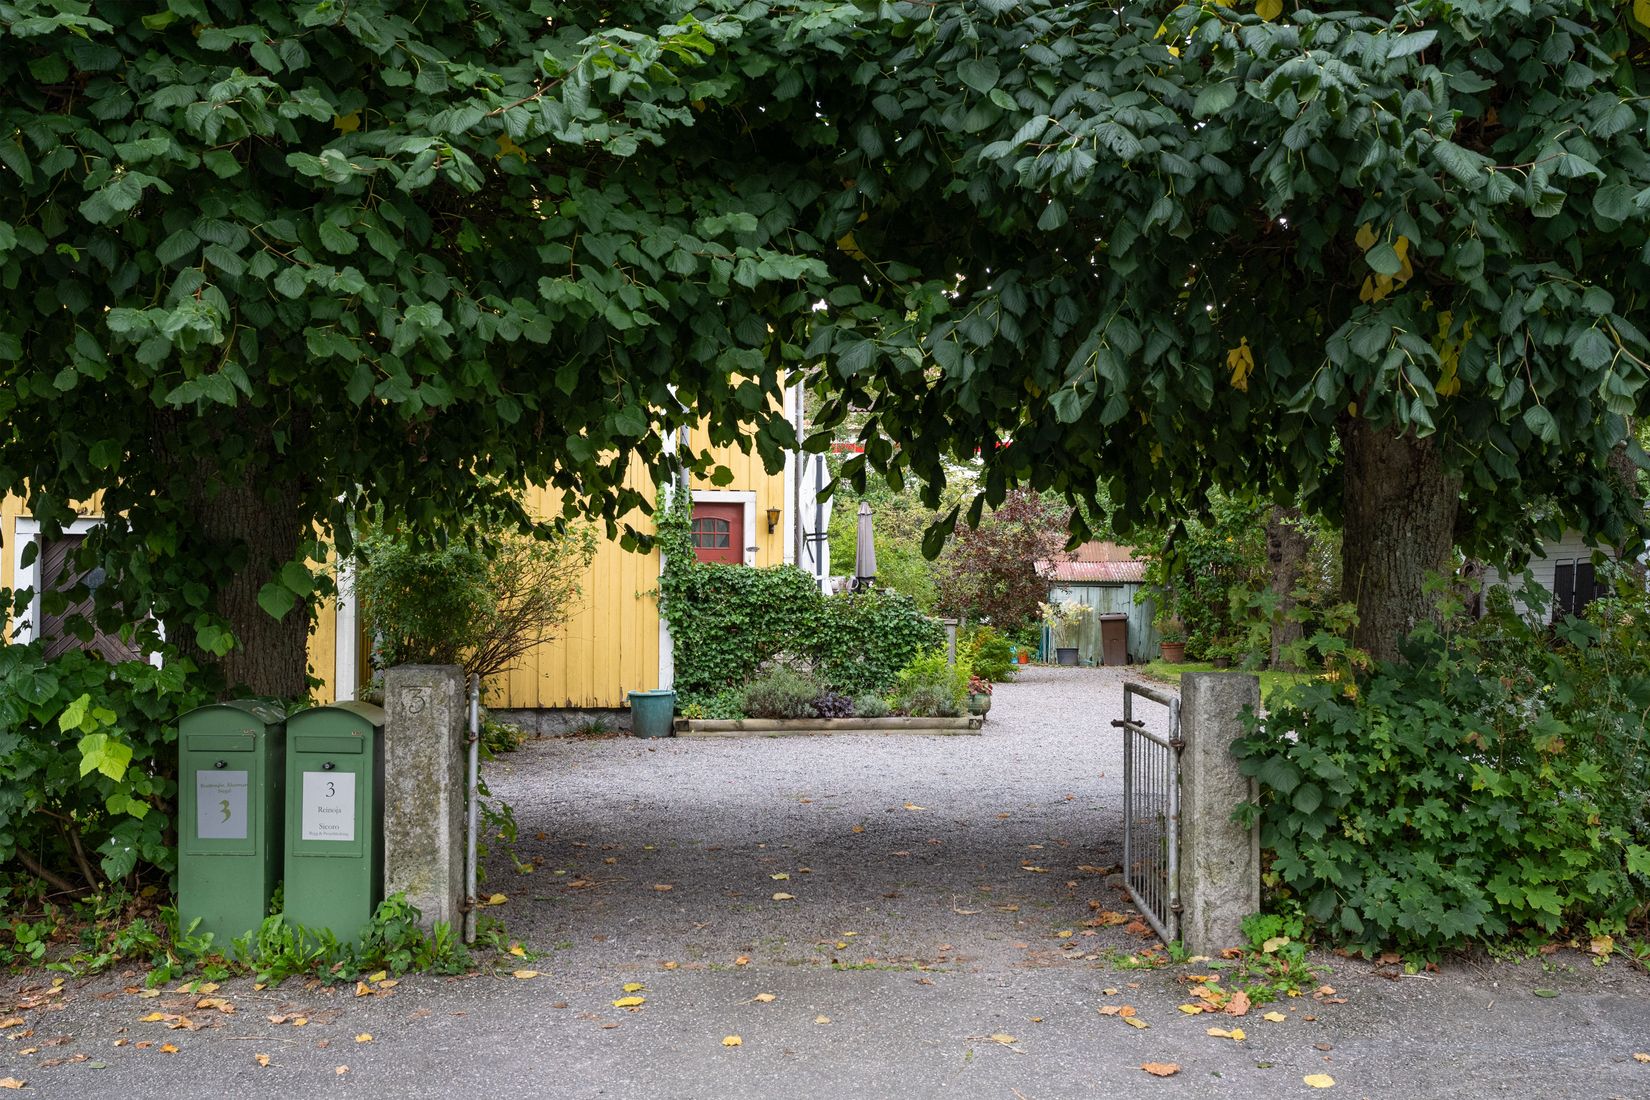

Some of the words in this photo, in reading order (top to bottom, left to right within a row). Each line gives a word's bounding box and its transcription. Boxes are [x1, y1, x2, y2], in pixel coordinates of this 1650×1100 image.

[408, 688, 426, 714] 3
[325, 781, 336, 798] 3
[218, 799, 232, 823] 3
